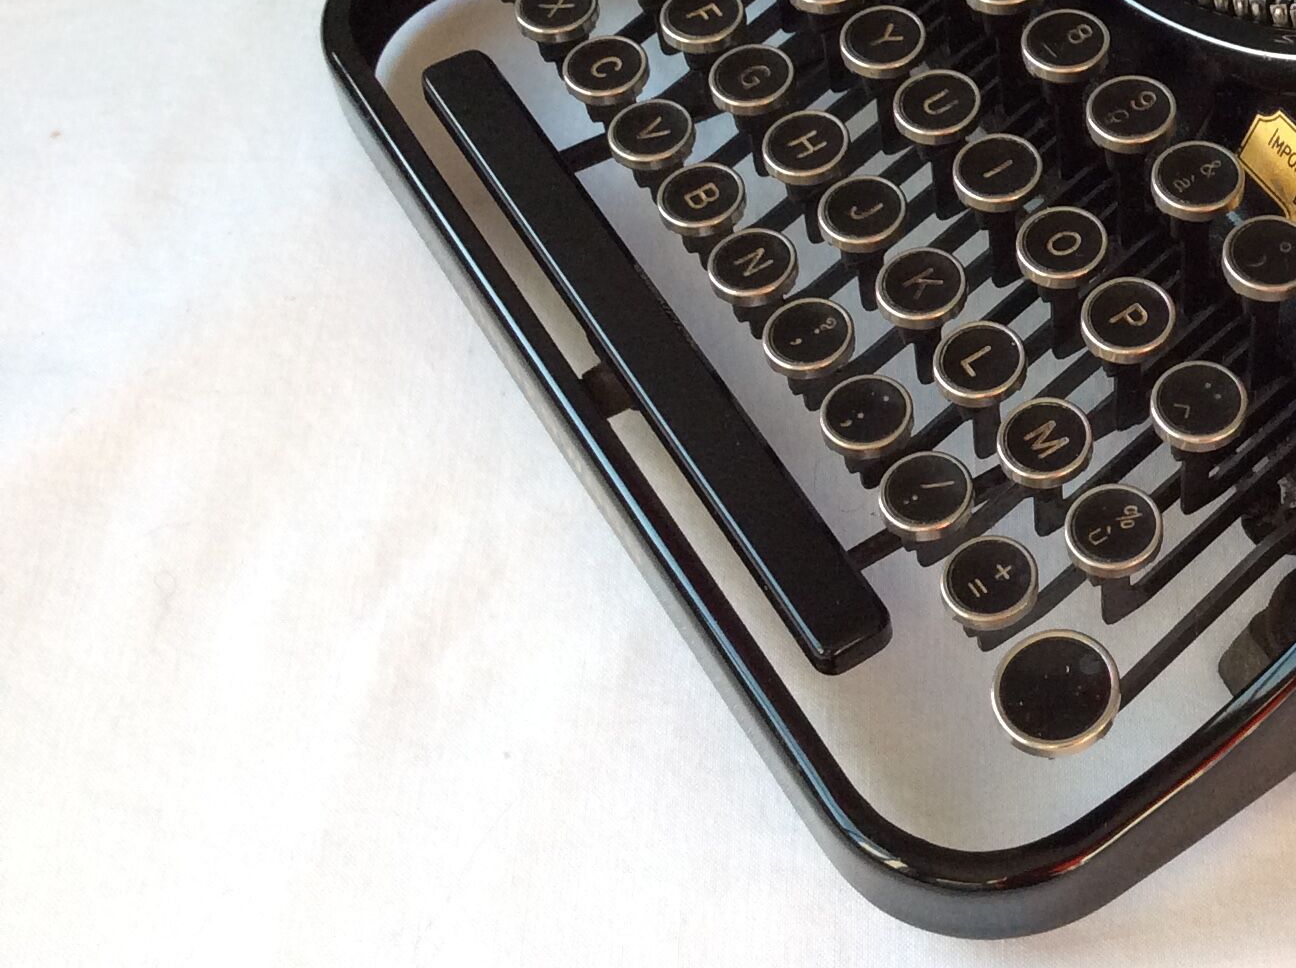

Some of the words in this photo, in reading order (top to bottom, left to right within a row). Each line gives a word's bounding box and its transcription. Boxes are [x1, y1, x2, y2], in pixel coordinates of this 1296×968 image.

[686, 2, 723, 20] F
[873, 22, 904, 45] Y
[1067, 23, 1093, 45] 8
[590, 56, 623, 78] C
[740, 64, 772, 89] G
[923, 88, 958, 115] U
[1130, 90, 1158, 111] 9
[636, 116, 671, 139] V
[788, 129, 828, 158] H
[684, 182, 720, 210] B
[849, 202, 884, 220] J
[1047, 231, 1082, 256] O
[735, 247, 774, 277] N
[903, 267, 944, 299] K
[1109, 302, 1149, 326] P
[960, 345, 992, 378] L
[1023, 419, 1070, 459] M
